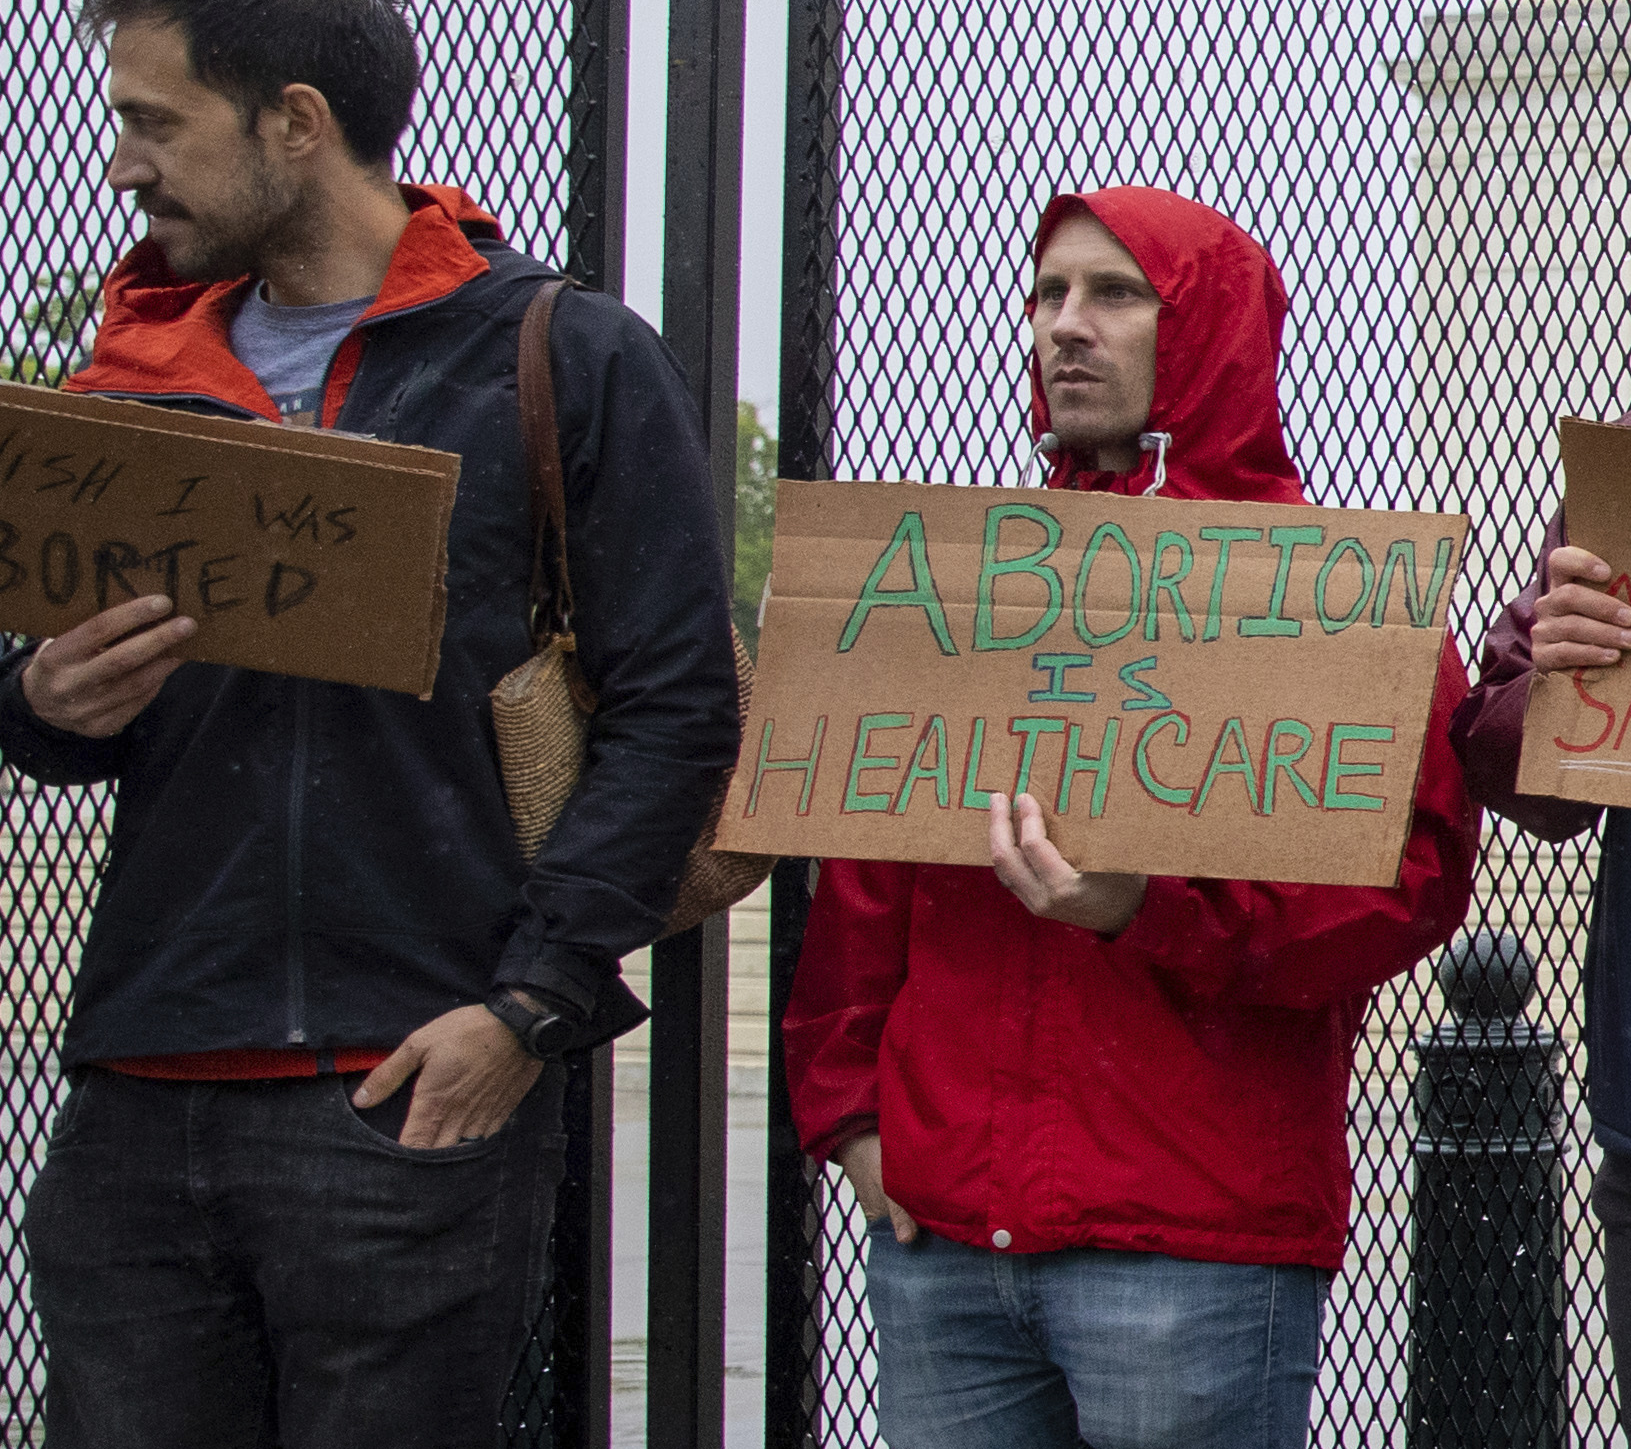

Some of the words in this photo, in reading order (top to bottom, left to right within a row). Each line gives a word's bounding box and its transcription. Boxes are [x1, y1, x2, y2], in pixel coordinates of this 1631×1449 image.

[0, 428, 126, 504] ISH
[157, 476, 208, 516] I
[254, 494, 357, 544] WAS
[839, 503, 1454, 656] ABORTION
[1029, 653, 1173, 711] IS
[744, 710, 1396, 818] HEALTHCARE
